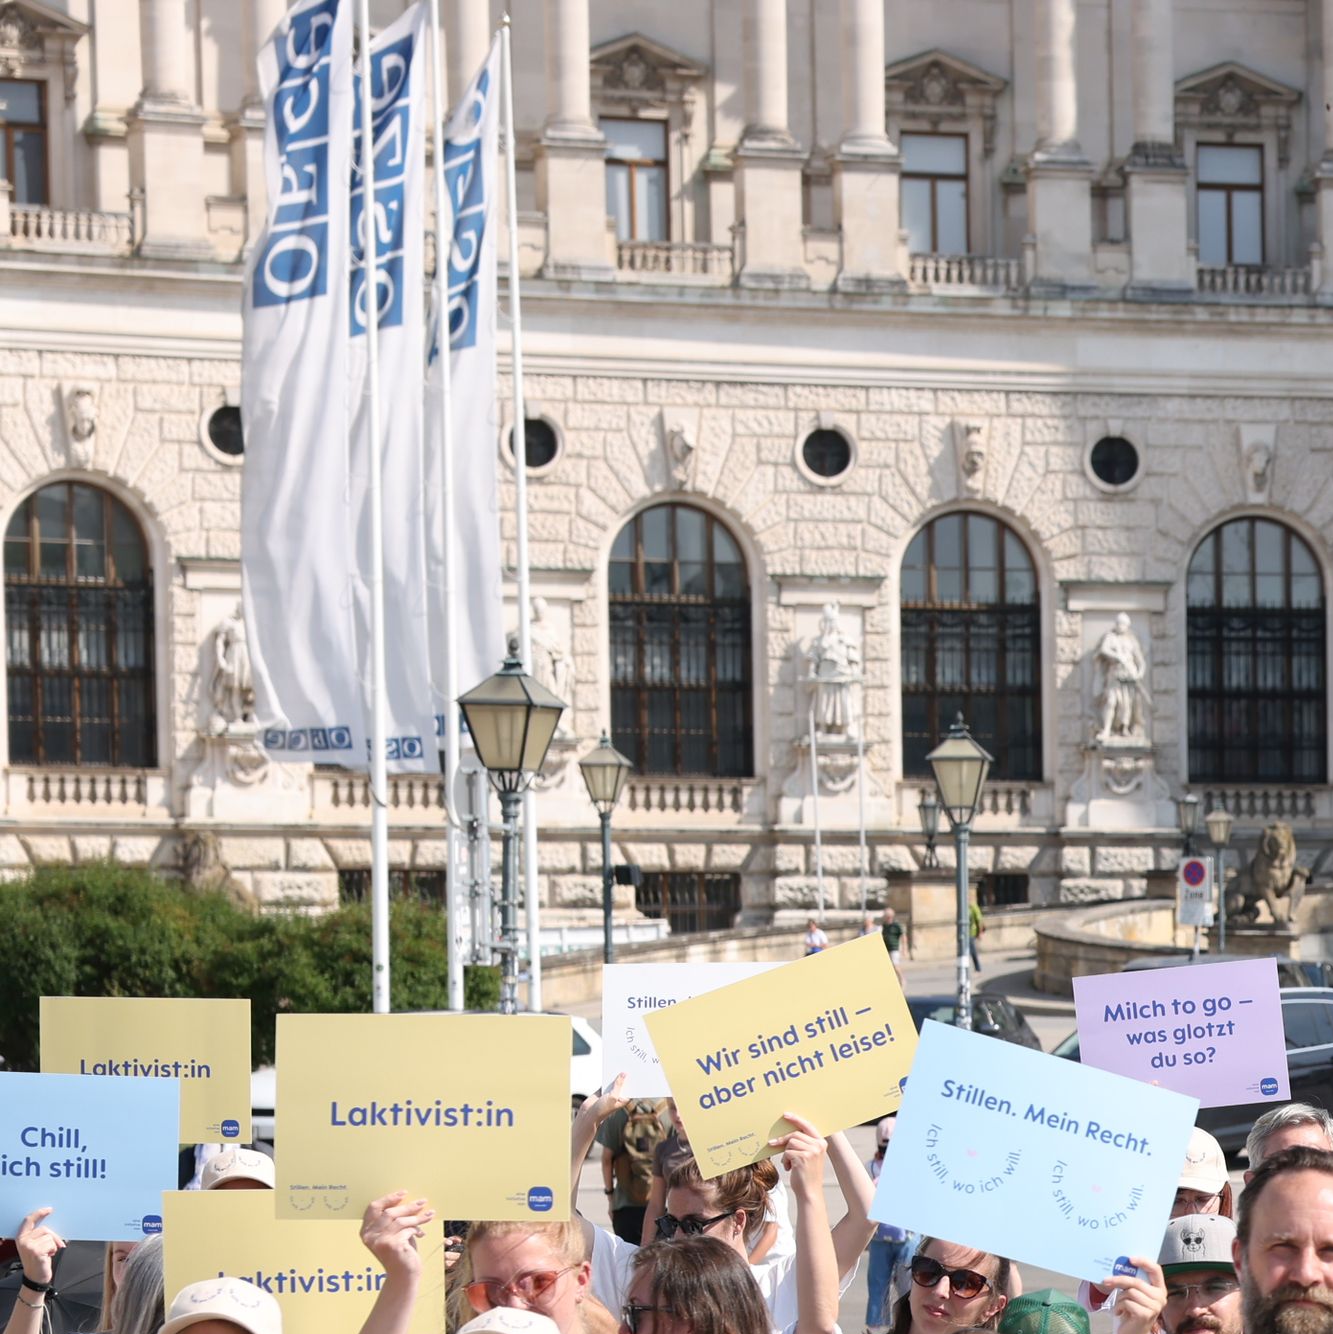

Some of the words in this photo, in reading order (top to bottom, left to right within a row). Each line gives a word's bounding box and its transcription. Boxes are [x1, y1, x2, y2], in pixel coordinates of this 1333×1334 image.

[1103, 1000, 1165, 1022] Milch
[1171, 998, 1196, 1015] to
[1202, 996, 1232, 1017] go
[695, 1047, 741, 1076] Wir
[747, 1024, 800, 1059] sind
[804, 1006, 850, 1039] still
[1126, 1029, 1167, 1045] was
[1173, 1020, 1235, 1045] glotzt
[630, 1044, 648, 1064] still,
[699, 1076, 755, 1110] aber
[762, 1049, 824, 1088] nicht
[829, 1022, 896, 1062] leise!
[1151, 1051, 1177, 1069] du
[1183, 1046, 1217, 1066] so?
[80, 1059, 211, 1078] Laktivist:in
[330, 1099, 514, 1127] Laktivist:in
[941, 1079, 1017, 1117] Stillen.
[1024, 1104, 1080, 1134] Mein
[1085, 1121, 1152, 1157] Recht.
[20, 1126, 87, 1153] Chill,
[925, 1123, 943, 1148] Ich
[1, 1154, 40, 1177] ich
[49, 1157, 107, 1179] still!
[927, 1153, 950, 1184] still,
[1003, 1148, 1022, 1176] will.
[1051, 1160, 1068, 1184] Ich
[952, 1180, 975, 1194] wo
[980, 1176, 1004, 1193] ich
[1052, 1189, 1075, 1220] still,
[1126, 1184, 1145, 1212] will.
[1078, 1216, 1100, 1230] wo
[1104, 1212, 1127, 1229] ich
[218, 1267, 388, 1294] ktivist:i
